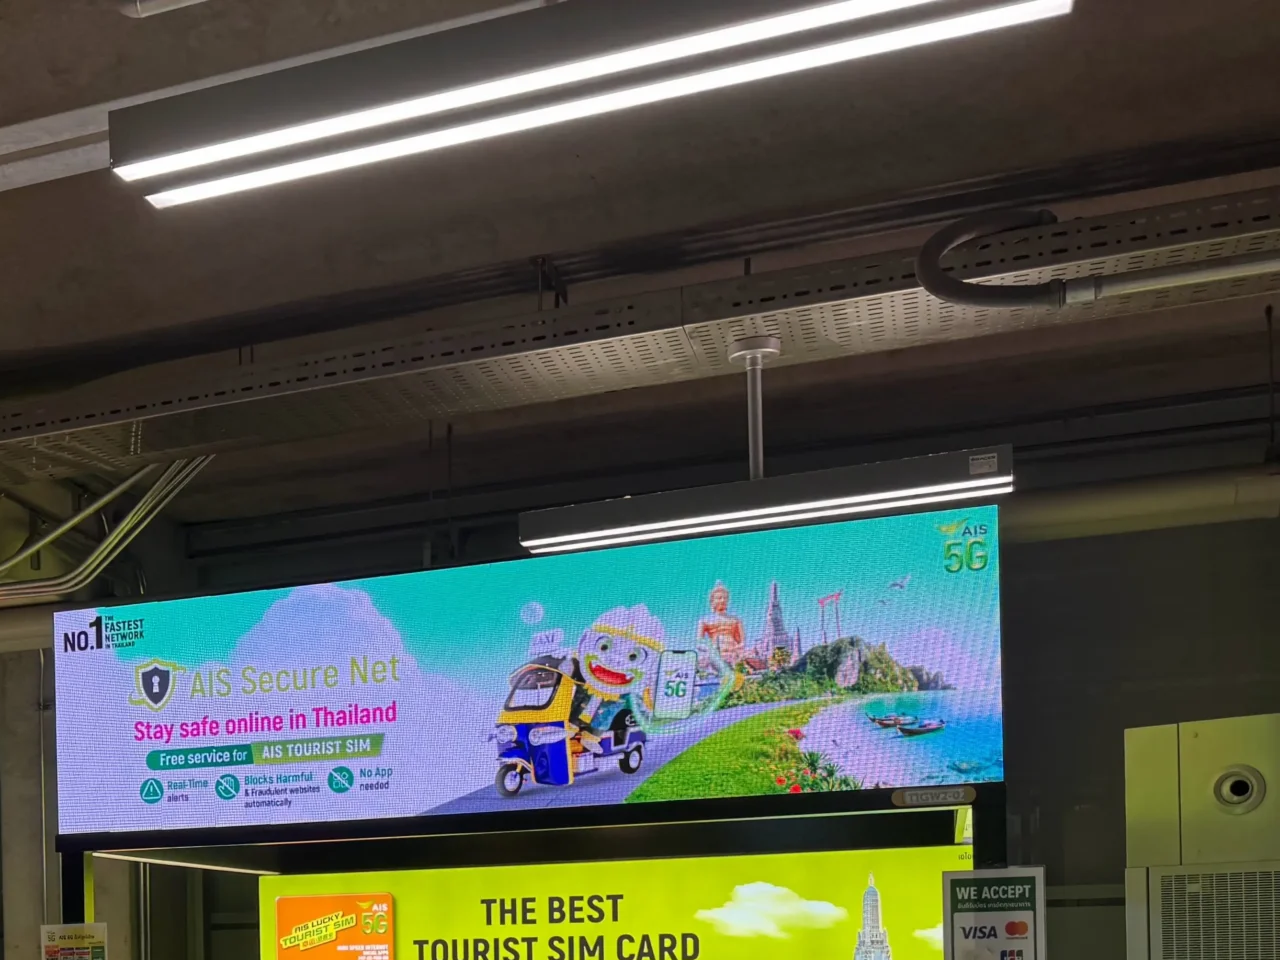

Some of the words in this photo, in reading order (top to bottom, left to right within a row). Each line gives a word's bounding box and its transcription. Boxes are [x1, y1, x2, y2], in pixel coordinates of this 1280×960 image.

[962, 524, 988, 536] AIS
[943, 537, 988, 573] 5G
[104, 618, 145, 633] FASTEST
[63, 615, 103, 653] NO.1
[104, 630, 145, 643] NETWORK
[190, 667, 232, 699] AIS
[241, 664, 339, 695] Secure
[349, 654, 400, 686] Net
[664, 680, 687, 698] 5G
[133, 720, 174, 744] Stay
[179, 715, 219, 739] safe
[225, 711, 283, 735] online
[289, 708, 306, 730] in
[312, 700, 398, 727] Thailand
[160, 752, 185, 767] Free
[187, 749, 230, 765] service
[232, 748, 247, 762] for
[262, 744, 282, 759] AIS
[287, 740, 340, 758] TOURIST
[346, 738, 371, 753] SIM
[244, 775, 274, 786] Blocks
[276, 771, 313, 784] Harmful
[360, 768, 374, 778] No
[376, 766, 393, 778] App
[167, 778, 209, 791] Real-Time
[251, 787, 288, 797] Fraudulent
[288, 785, 320, 795] websites
[360, 780, 390, 791] needed
[167, 793, 189, 803] alerts
[244, 798, 292, 809] automatically
[956, 886, 978, 900] WE
[981, 885, 1031, 899] ACCEPT
[372, 903, 388, 912] AIS
[480, 897, 537, 926] THE
[547, 894, 624, 924] BEST
[294, 923, 309, 933] AIS
[311, 912, 341, 928] LUCKY
[361, 911, 388, 935] 5G
[282, 924, 330, 946] TOURIST
[333, 916, 354, 930] SIM
[960, 925, 998, 940] VISA
